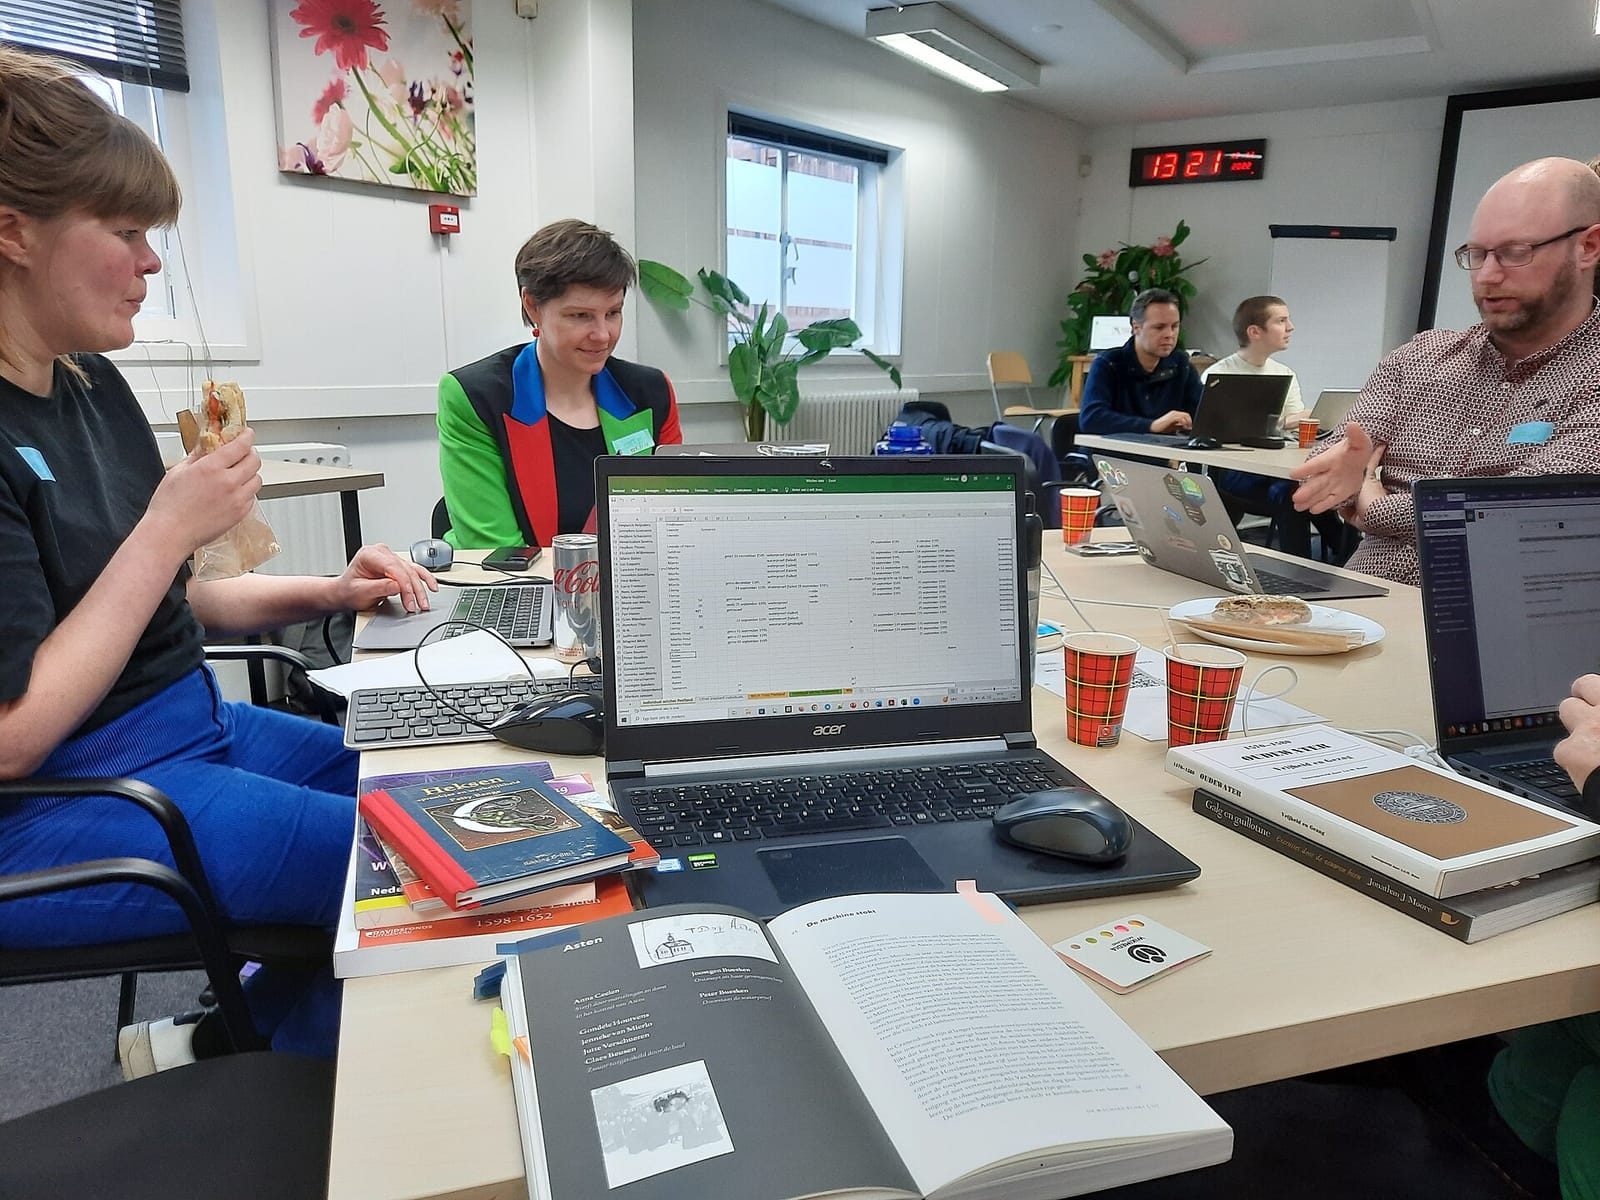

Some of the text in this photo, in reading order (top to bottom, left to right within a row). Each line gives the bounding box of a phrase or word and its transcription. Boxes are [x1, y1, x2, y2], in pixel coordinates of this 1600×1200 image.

[813, 724, 846, 736] acer
[1241, 743, 1332, 761] OUDEWATER
[422, 777, 504, 796] Heksen
[1200, 773, 1242, 798] OUDEWATER
[1205, 800, 1223, 819] Galg
[1224, 810, 1233, 820] en
[1234, 816, 1272, 838] guillotine
[1368, 878, 1400, 898] Jonathan
[1408, 896, 1433, 912] Moore
[477, 912, 553, 927] 1598-1652
[820, 912, 854, 923] machine
[563, 936, 603, 952] Asten
[574, 996, 594, 1004] Anna
[582, 1032, 611, 1046] Jenneke
[626, 1022, 653, 1033] Mierlo
[602, 1033, 650, 1050] Verschueren
